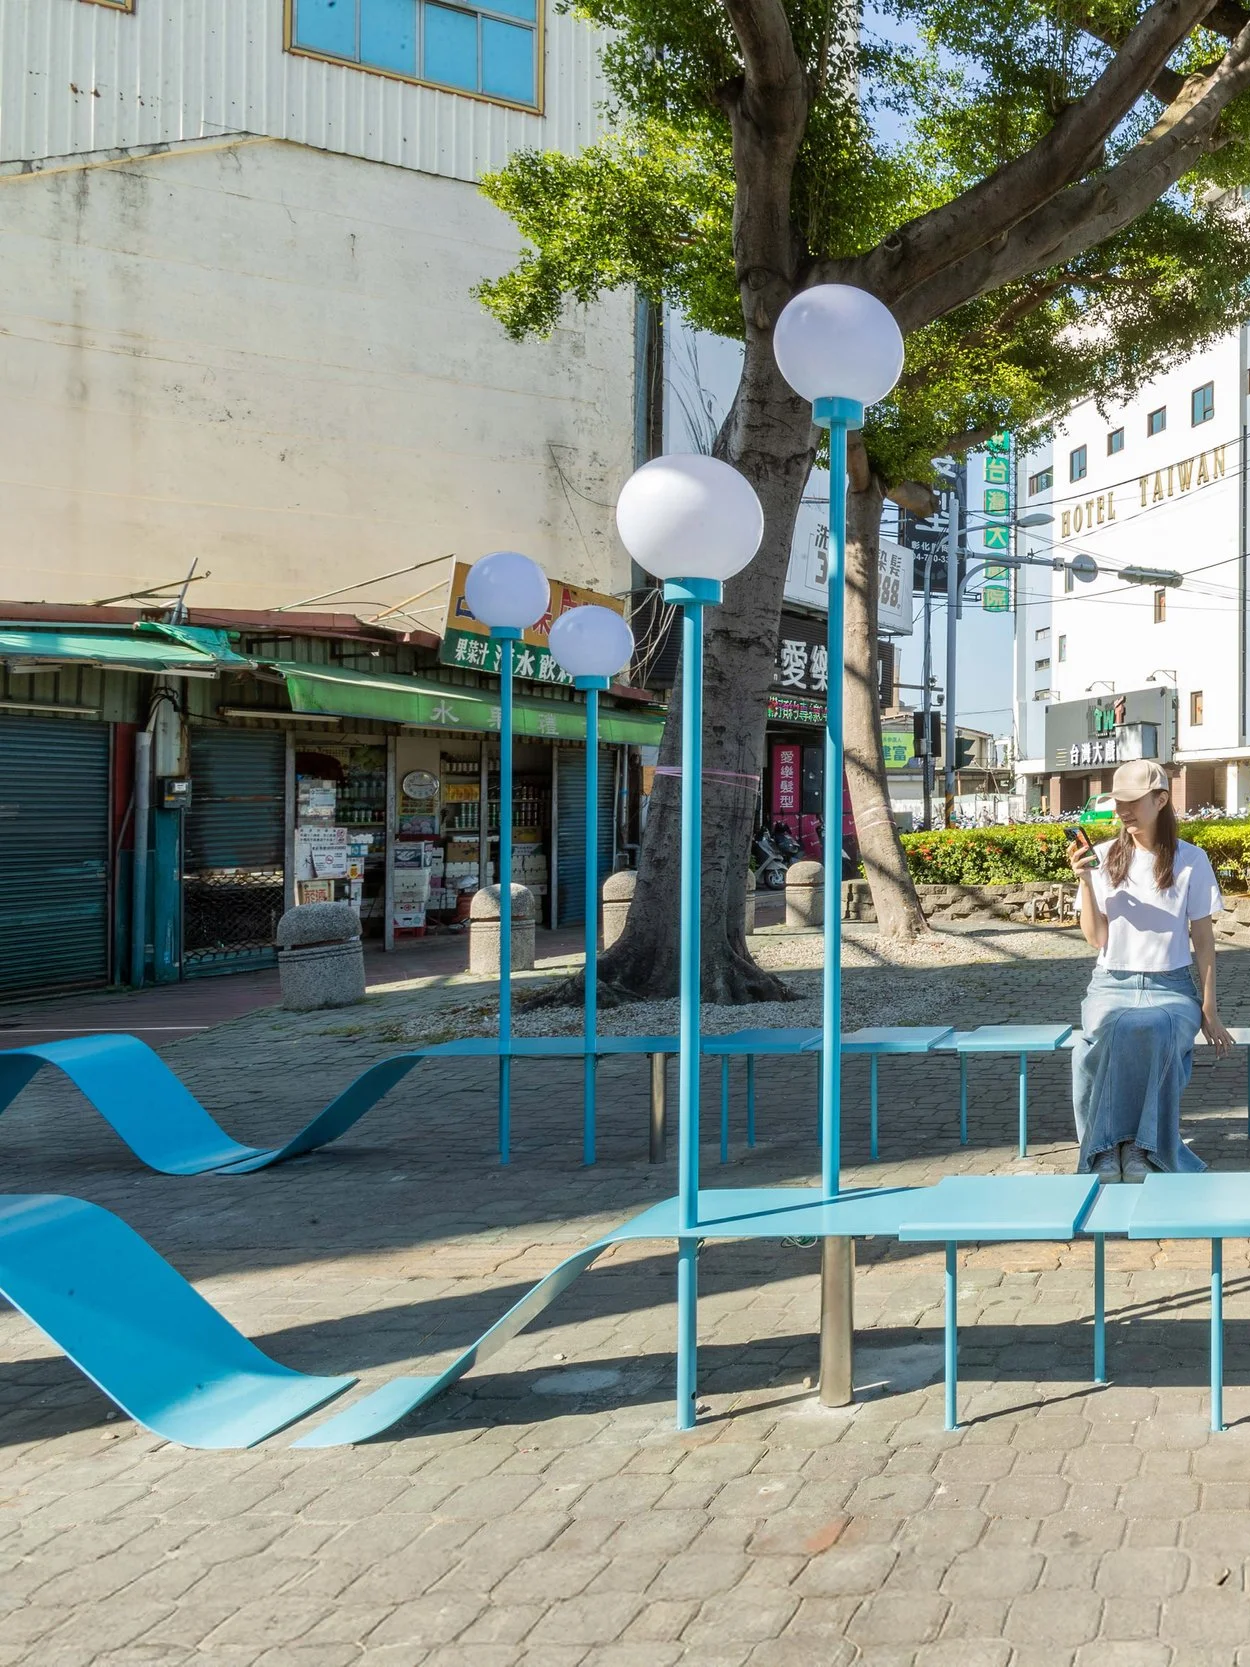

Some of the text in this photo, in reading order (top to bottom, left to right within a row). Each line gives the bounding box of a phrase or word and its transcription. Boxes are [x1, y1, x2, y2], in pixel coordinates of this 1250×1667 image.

[1061, 445, 1226, 538] HOTEL TAIWAN
[454, 637, 490, 666] 果菜汁
[1070, 739, 1120, 765] 台灣大戲
[780, 751, 794, 808] 愛樂髮型
